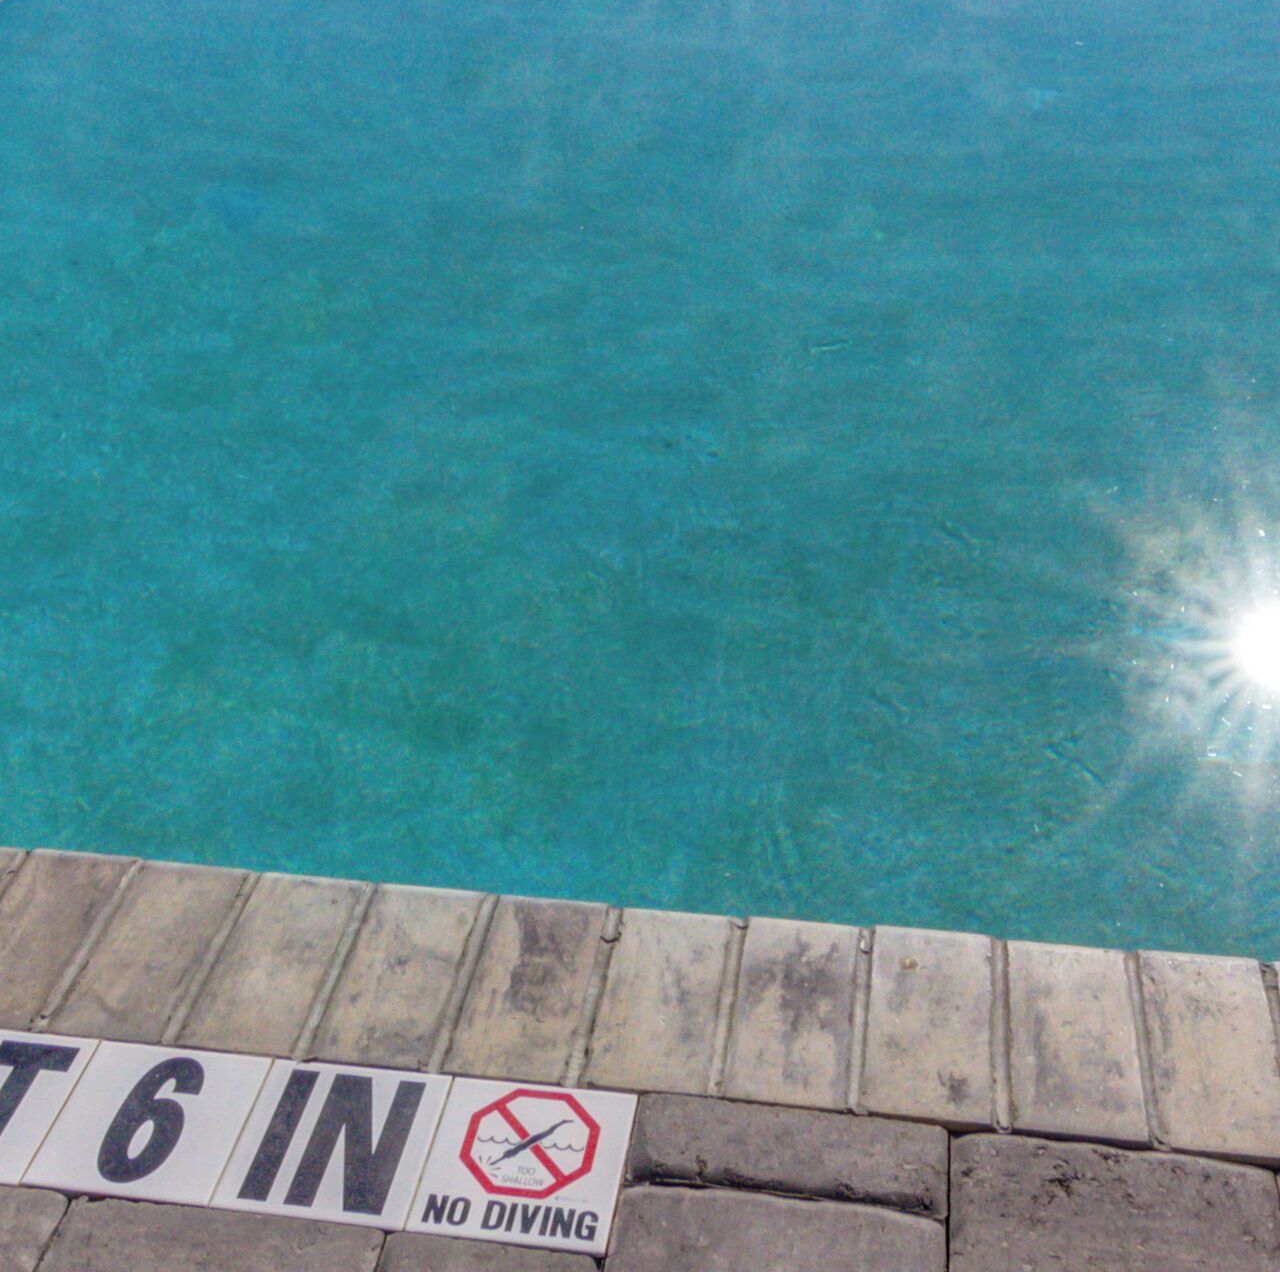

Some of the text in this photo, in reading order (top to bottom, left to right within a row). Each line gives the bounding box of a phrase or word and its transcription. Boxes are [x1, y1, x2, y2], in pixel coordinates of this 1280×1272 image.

[97, 1056, 206, 1184] 6
[236, 1069, 424, 1216] IN
[502, 1175, 545, 1187] SHALLOW
[516, 1166, 536, 1177] TOO
[421, 1194, 599, 1241] NO DIVING
